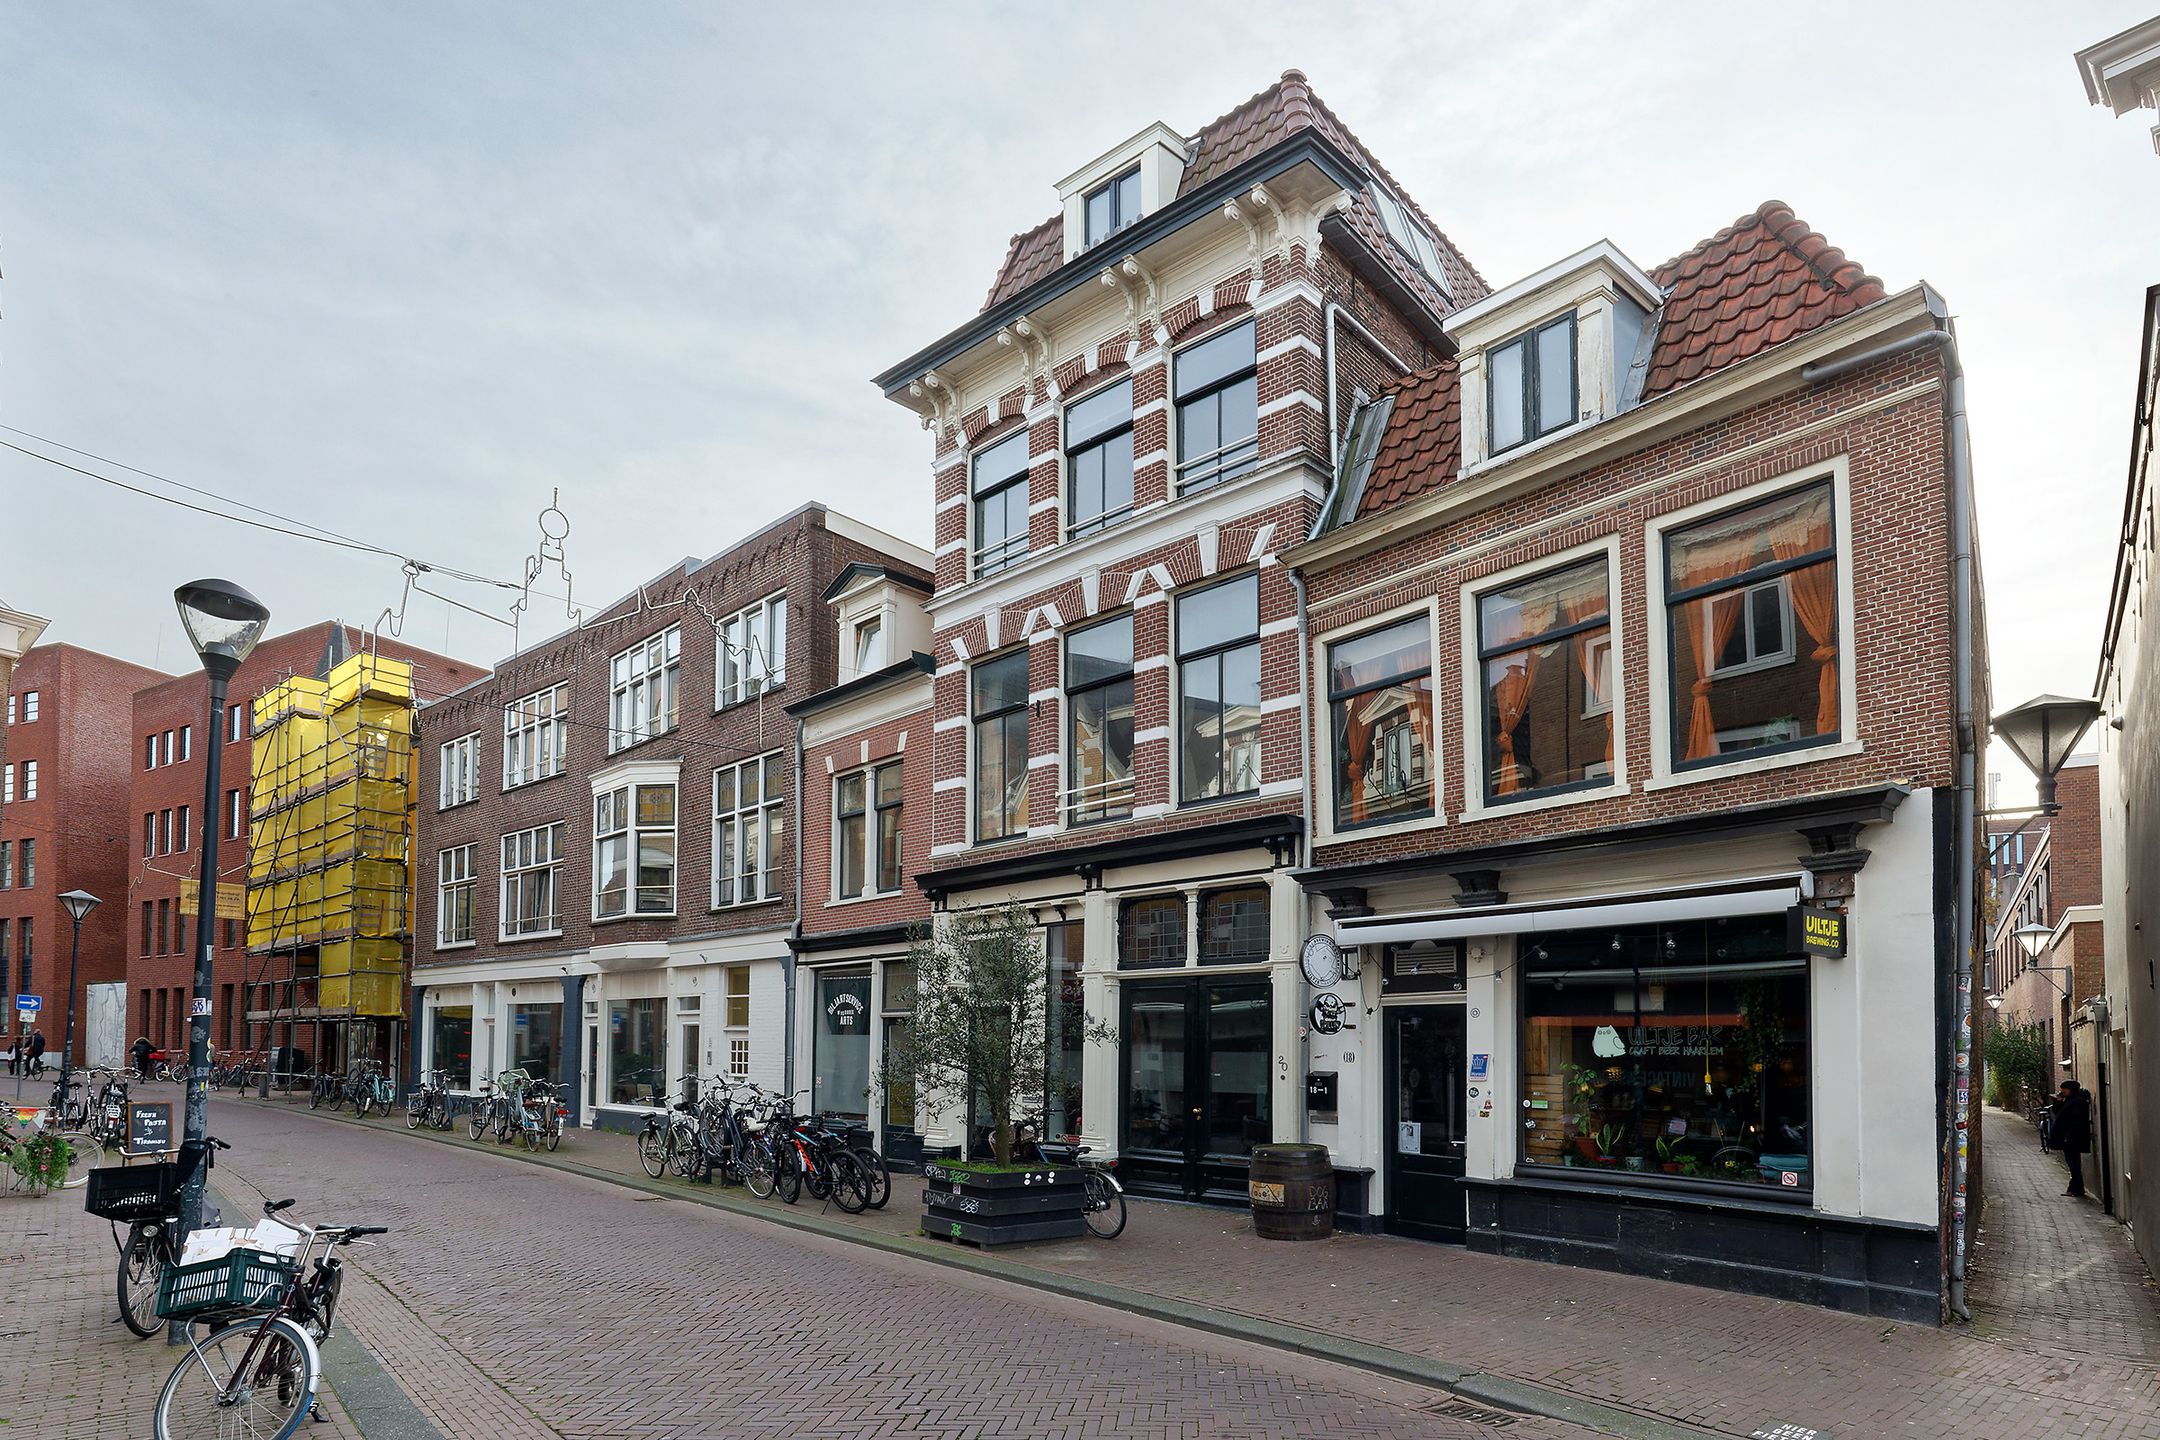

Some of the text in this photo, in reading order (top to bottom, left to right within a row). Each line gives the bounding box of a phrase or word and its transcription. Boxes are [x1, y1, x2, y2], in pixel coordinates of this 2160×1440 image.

[1806, 915, 1839, 937] UILTJE
[840, 1015, 853, 1025] ARTS
[1628, 1024, 1723, 1047] UILTJE BAR
[1629, 1046, 1657, 1056] CRAFT
[1658, 1046, 1680, 1055] BEER
[1278, 1055, 1288, 1071] 20
[1752, 1430, 1798, 1440] FIET
[1772, 1428, 1814, 1440] GEEN
[1781, 1424, 1817, 1436] HIER
